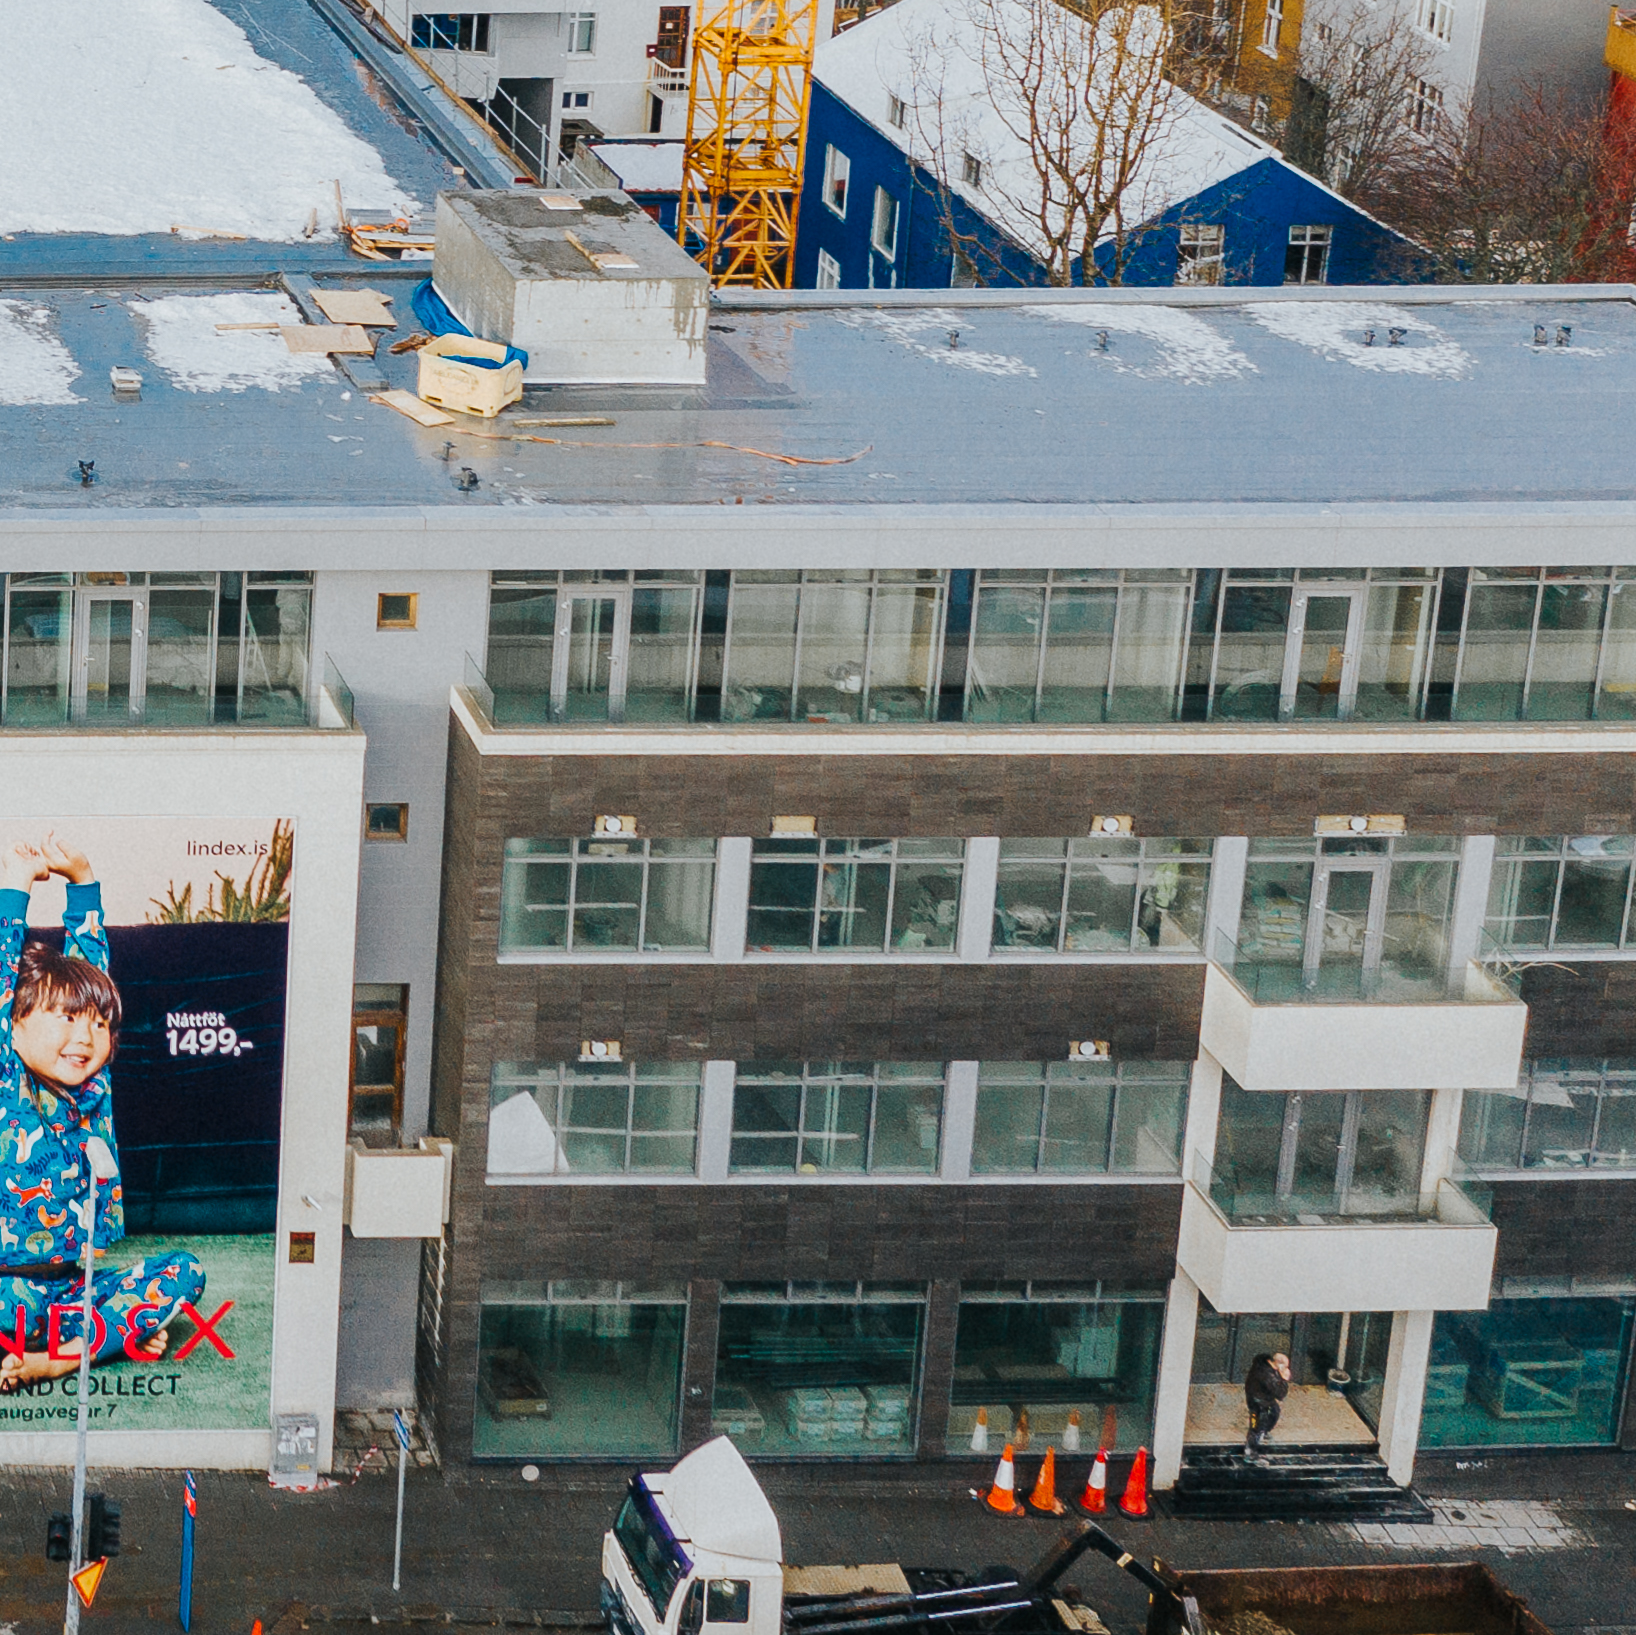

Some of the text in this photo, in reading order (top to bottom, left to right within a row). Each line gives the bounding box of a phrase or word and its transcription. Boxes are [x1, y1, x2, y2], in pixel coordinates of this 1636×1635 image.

[187, 840, 268, 856] lindex.is
[166, 1027, 254, 1057] 1499,-
[60, 1373, 182, 1397] COLLECT
[106, 1403, 117, 1419] 7
